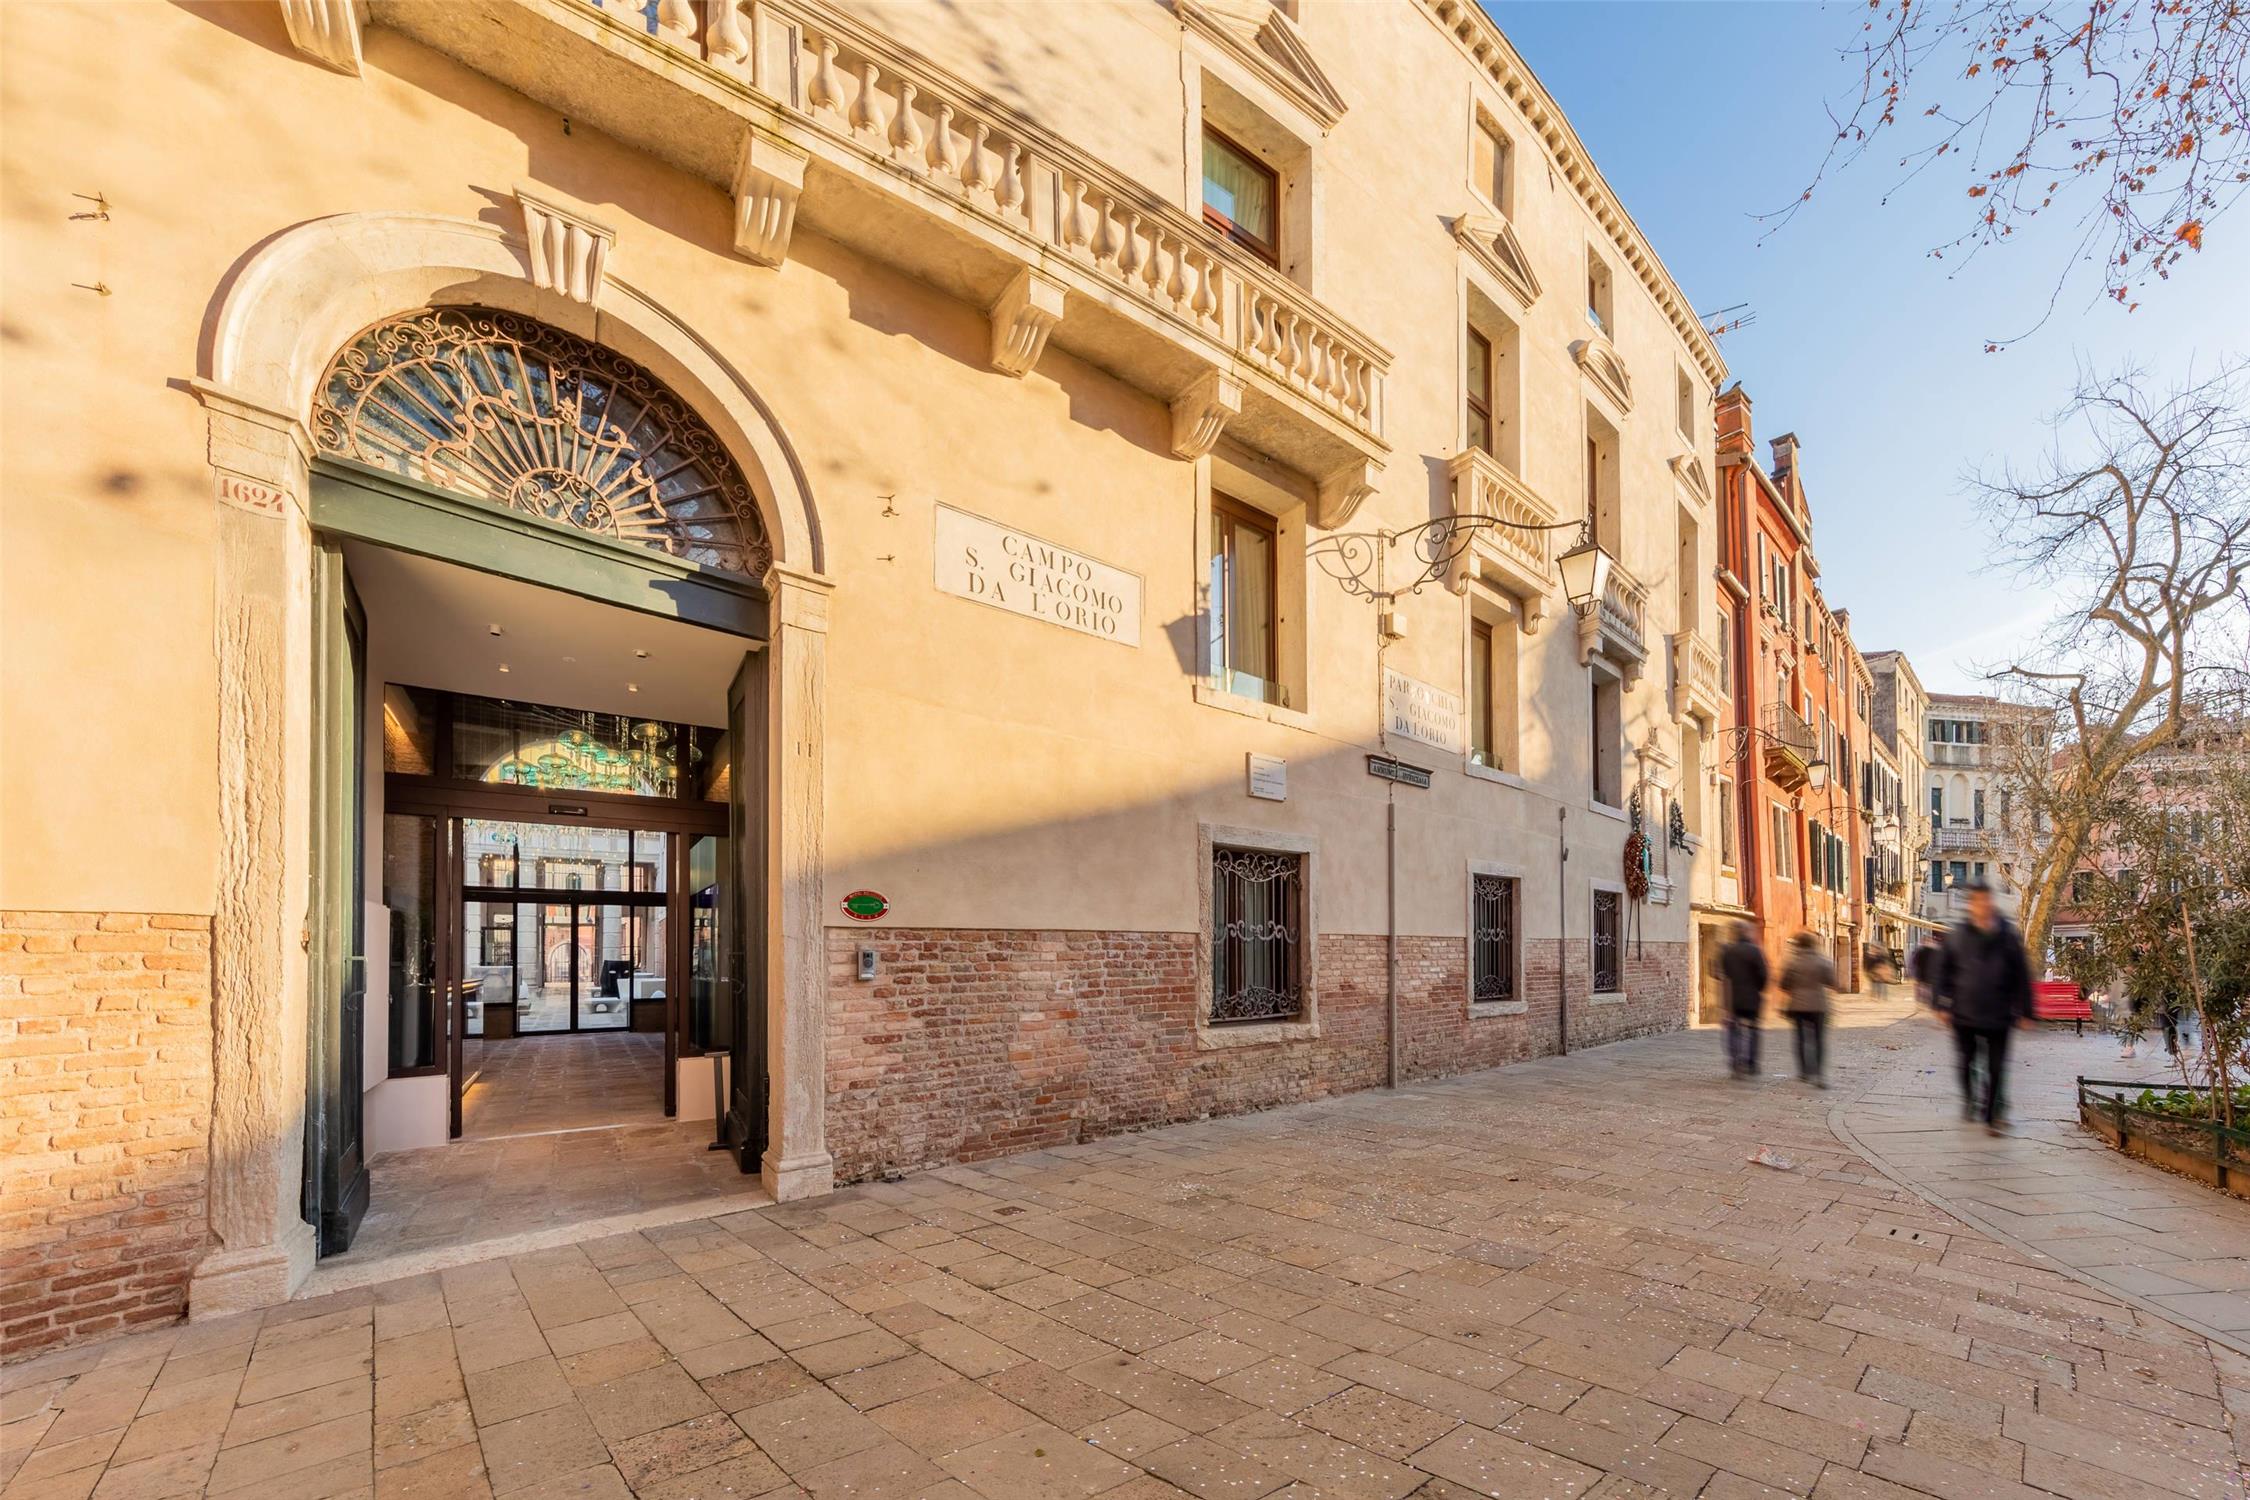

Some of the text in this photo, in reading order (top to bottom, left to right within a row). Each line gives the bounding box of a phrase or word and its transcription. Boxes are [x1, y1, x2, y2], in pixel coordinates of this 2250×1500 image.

[1002, 535, 1092, 582] CAMPO
[965, 547, 1123, 614] S. GIACOMO
[968, 572, 1006, 603] DA
[1395, 715, 1410, 734] DA
[1409, 703, 1456, 730] GIACOMO
